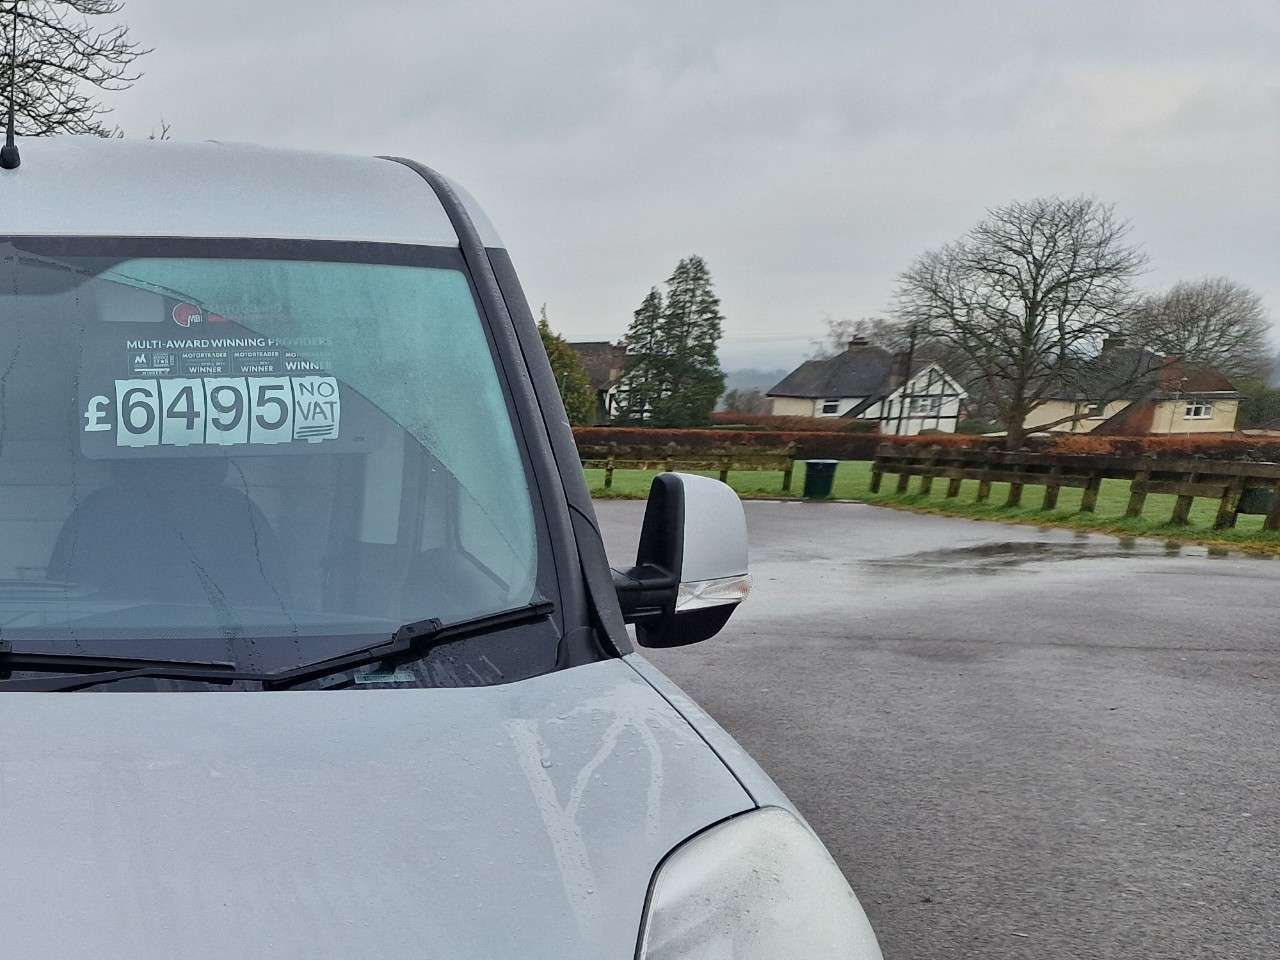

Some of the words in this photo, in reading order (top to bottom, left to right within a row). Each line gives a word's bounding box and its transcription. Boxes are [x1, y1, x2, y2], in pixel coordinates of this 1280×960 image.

[126, 340, 209, 349] MULTI-AWARD
[211, 338, 265, 349] WINNING
[241, 365, 273, 373] WINNER
[299, 381, 335, 398] NO
[296, 400, 337, 423] VAT
